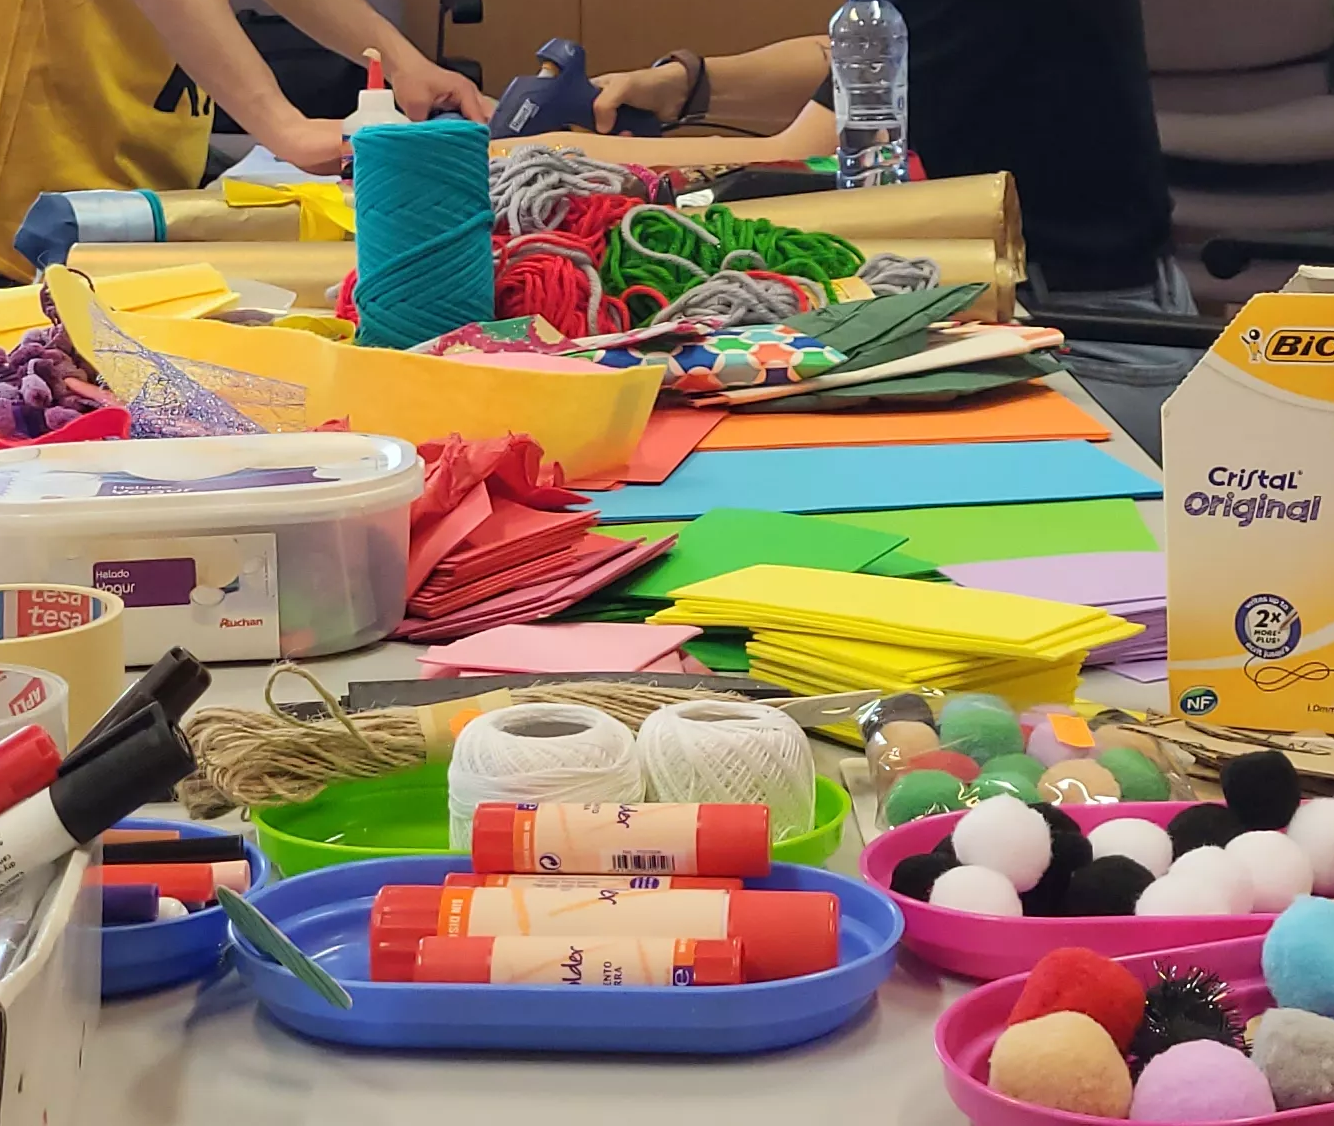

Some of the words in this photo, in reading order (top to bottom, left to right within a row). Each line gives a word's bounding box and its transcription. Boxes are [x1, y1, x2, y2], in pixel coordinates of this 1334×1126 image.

[1184, 492, 1322, 527] Original
[96, 569, 130, 579] Helado
[96, 582, 135, 596] Yogur
[28, 608, 82, 627] tesa
[219, 617, 263, 628] Auchan
[12, 685, 43, 716] APLI
[1186, 696, 1214, 710] NF
[603, 961, 613, 985] ENTO
[613, 966, 622, 985] RRA
